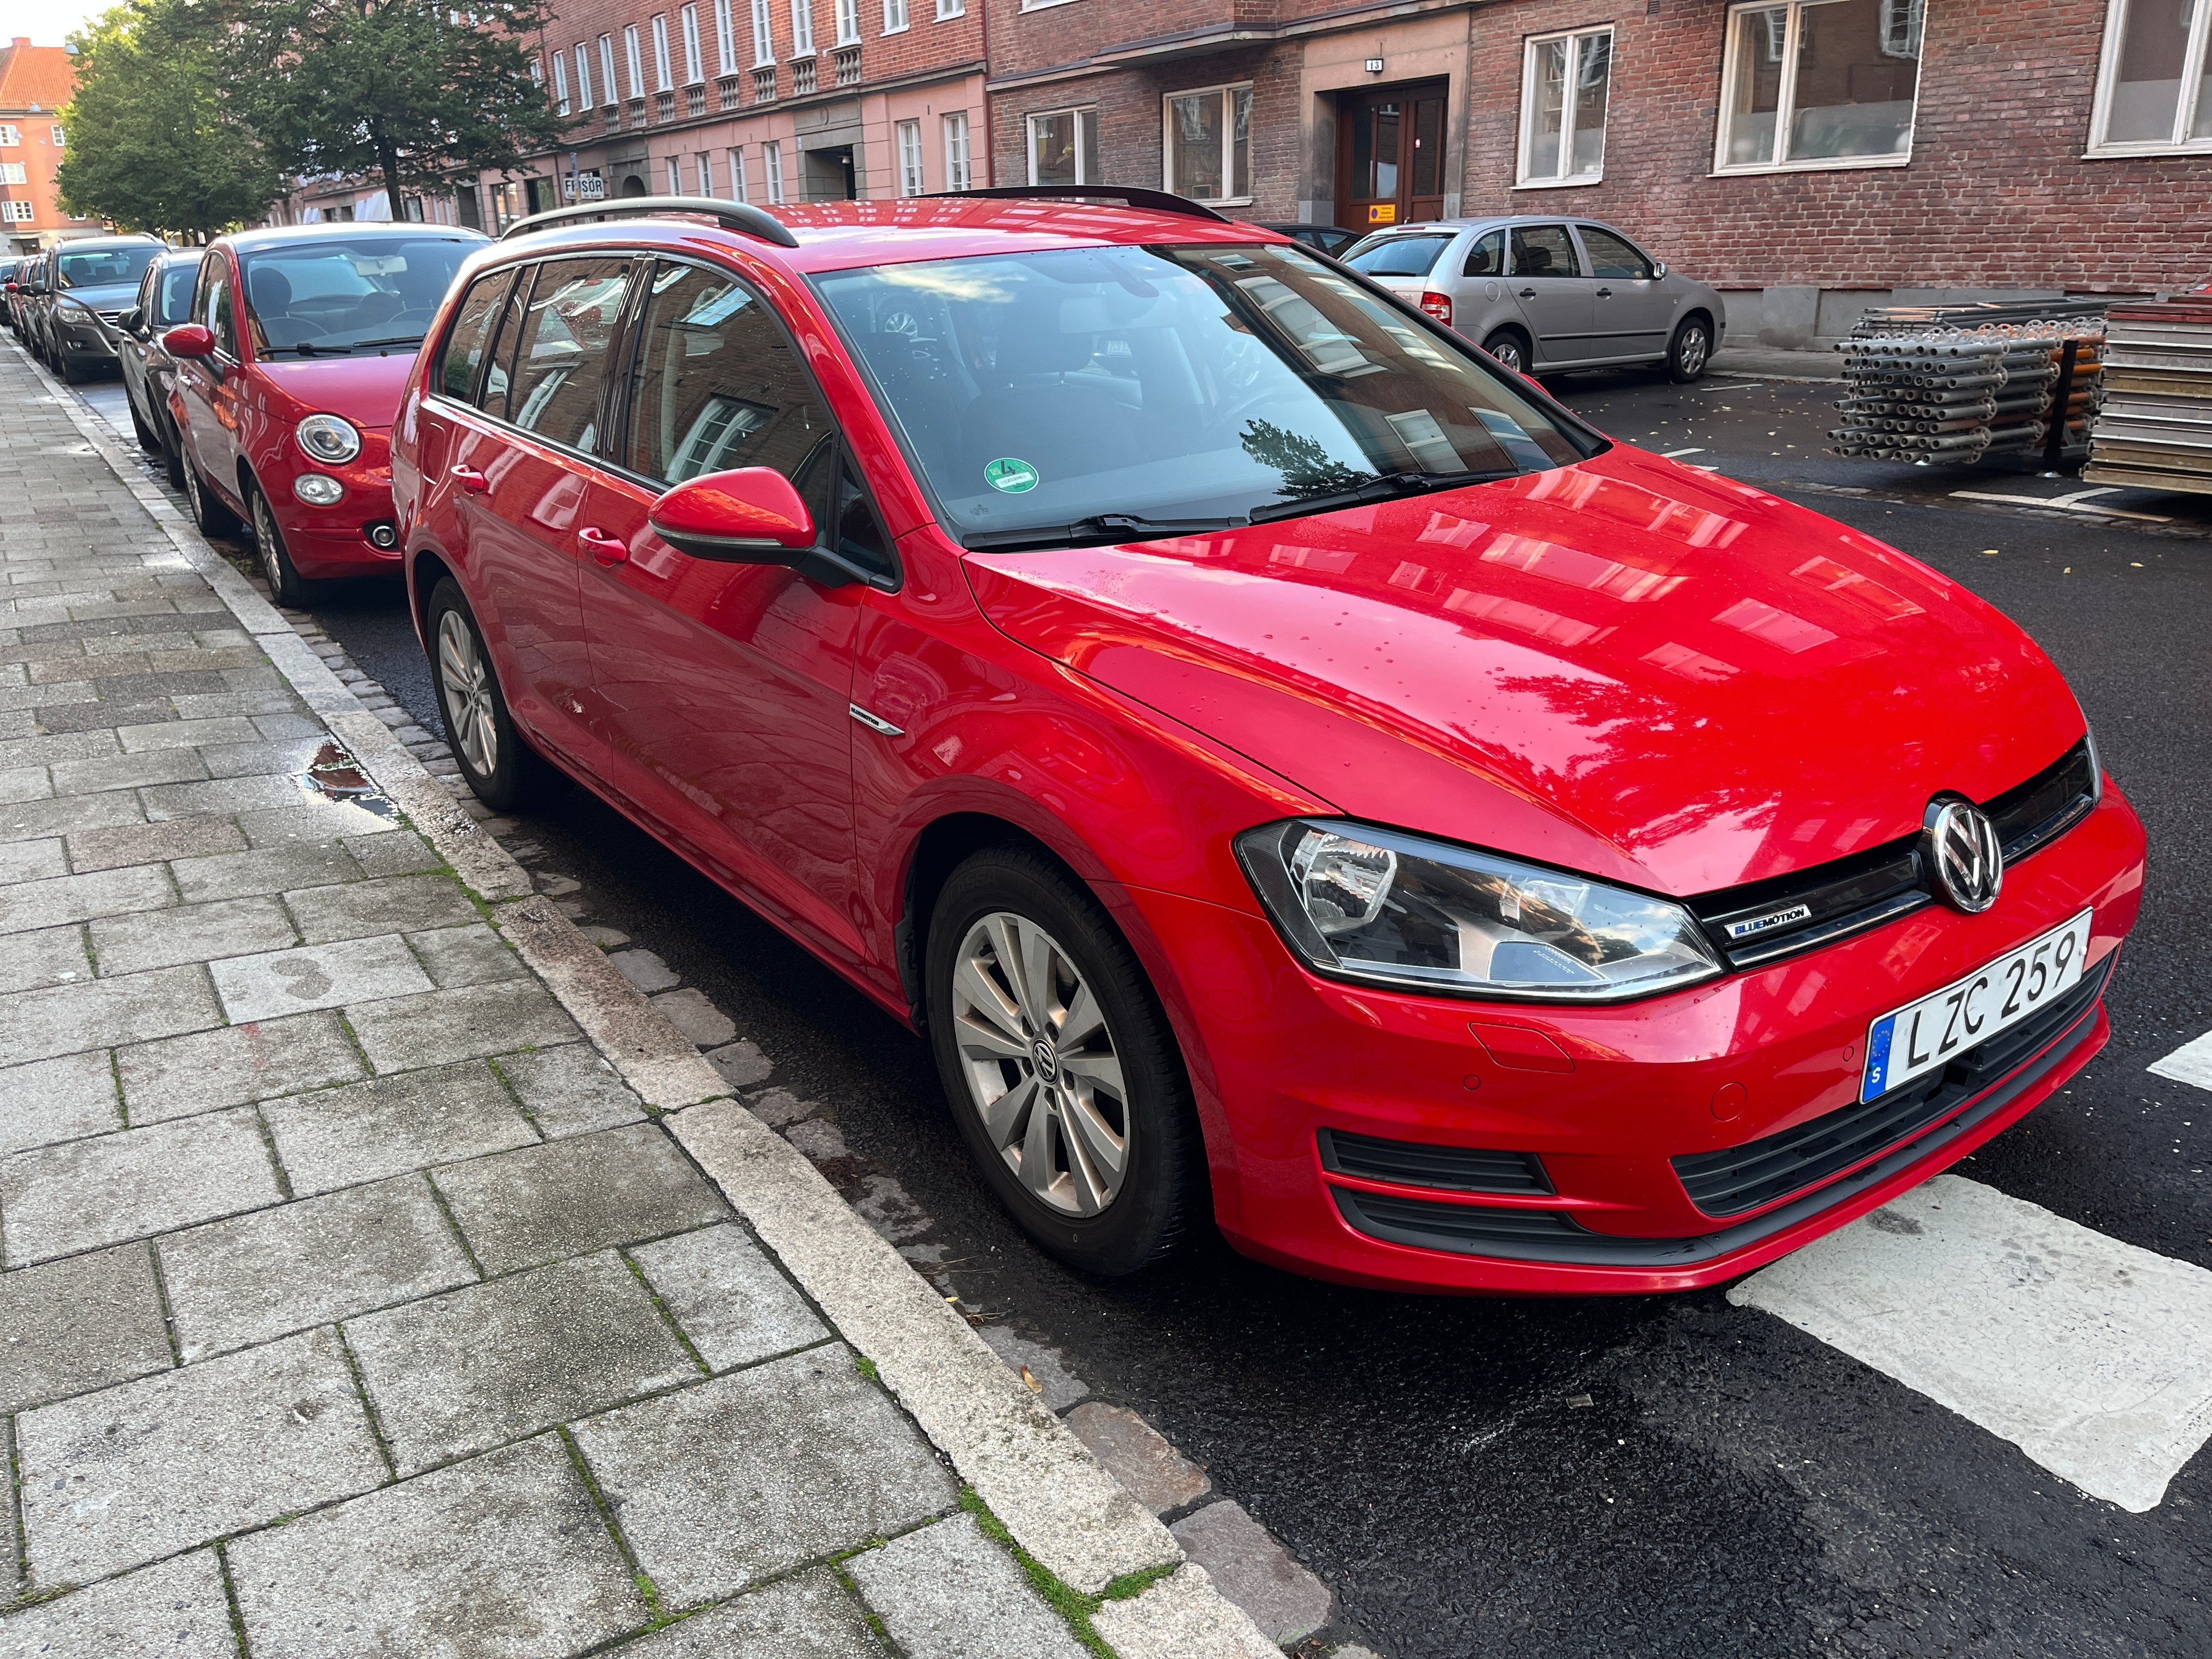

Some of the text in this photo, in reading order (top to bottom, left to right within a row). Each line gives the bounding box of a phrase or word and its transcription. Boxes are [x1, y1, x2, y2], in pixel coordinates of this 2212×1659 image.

[1370, 61, 1379, 70] 13
[1001, 460, 1015, 475] 4
[851, 707, 879, 726] BLUEMOTION
[1735, 908, 1805, 935] BLUEMOTION
[1906, 930, 2076, 1070] LZC 259
[1871, 1066, 1882, 1084] S
